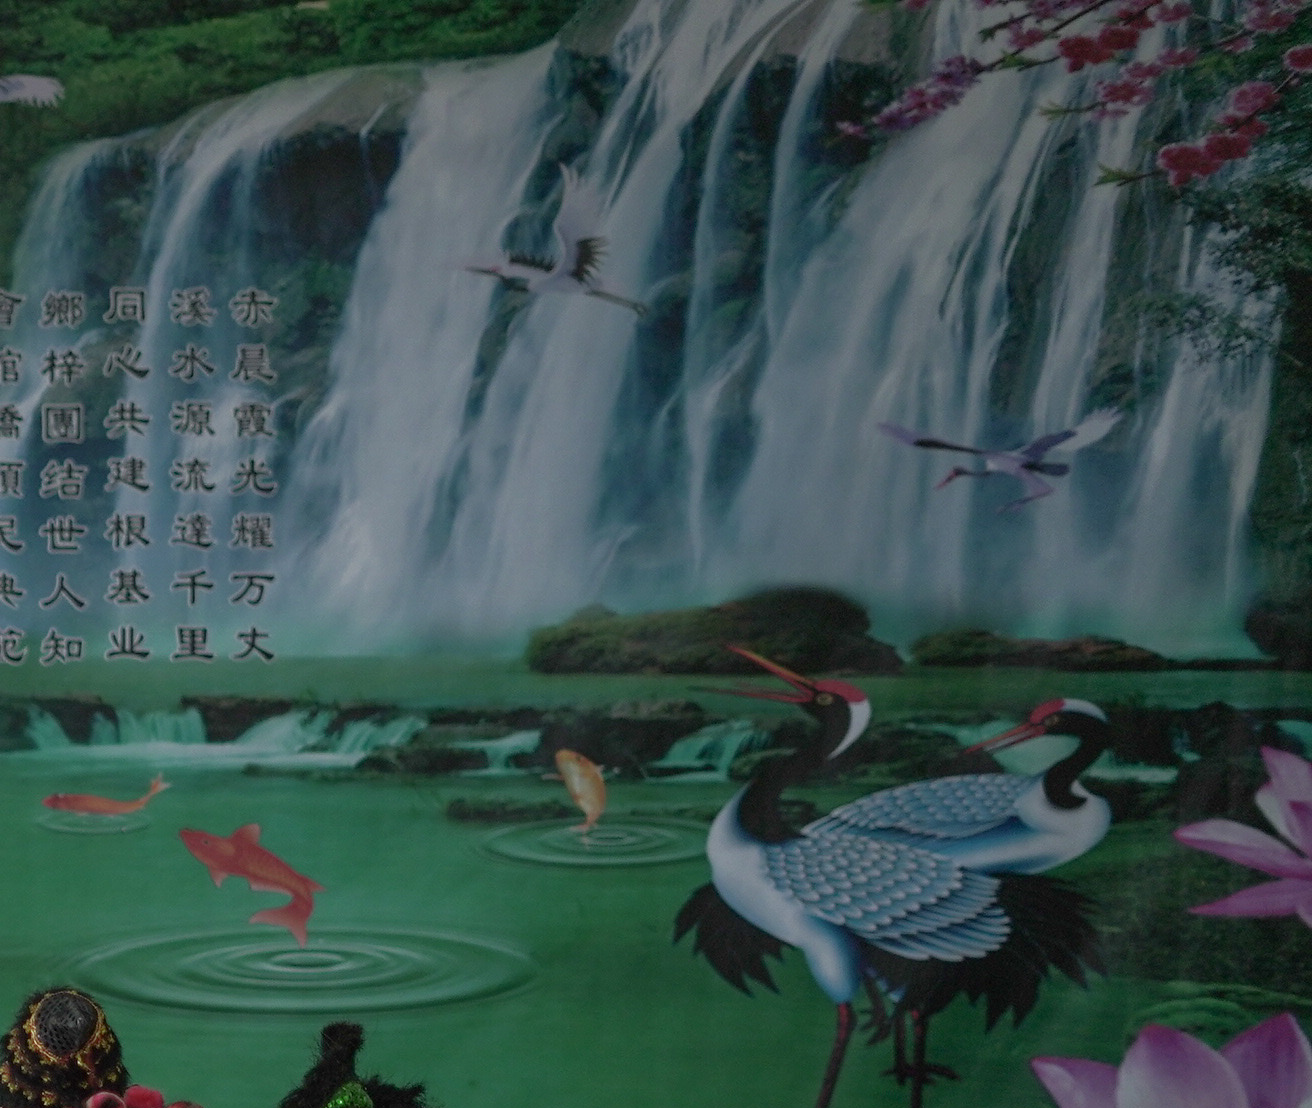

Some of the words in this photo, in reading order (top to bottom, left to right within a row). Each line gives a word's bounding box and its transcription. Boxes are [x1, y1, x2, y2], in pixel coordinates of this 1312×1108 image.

[40, 290, 86, 664] 鄉梓團结世人知
[105, 288, 151, 660] 同心共建根基业
[170, 289, 217, 663] 溪水源流達千里
[229, 290, 276, 662] 赤晨霞光耀万丈
